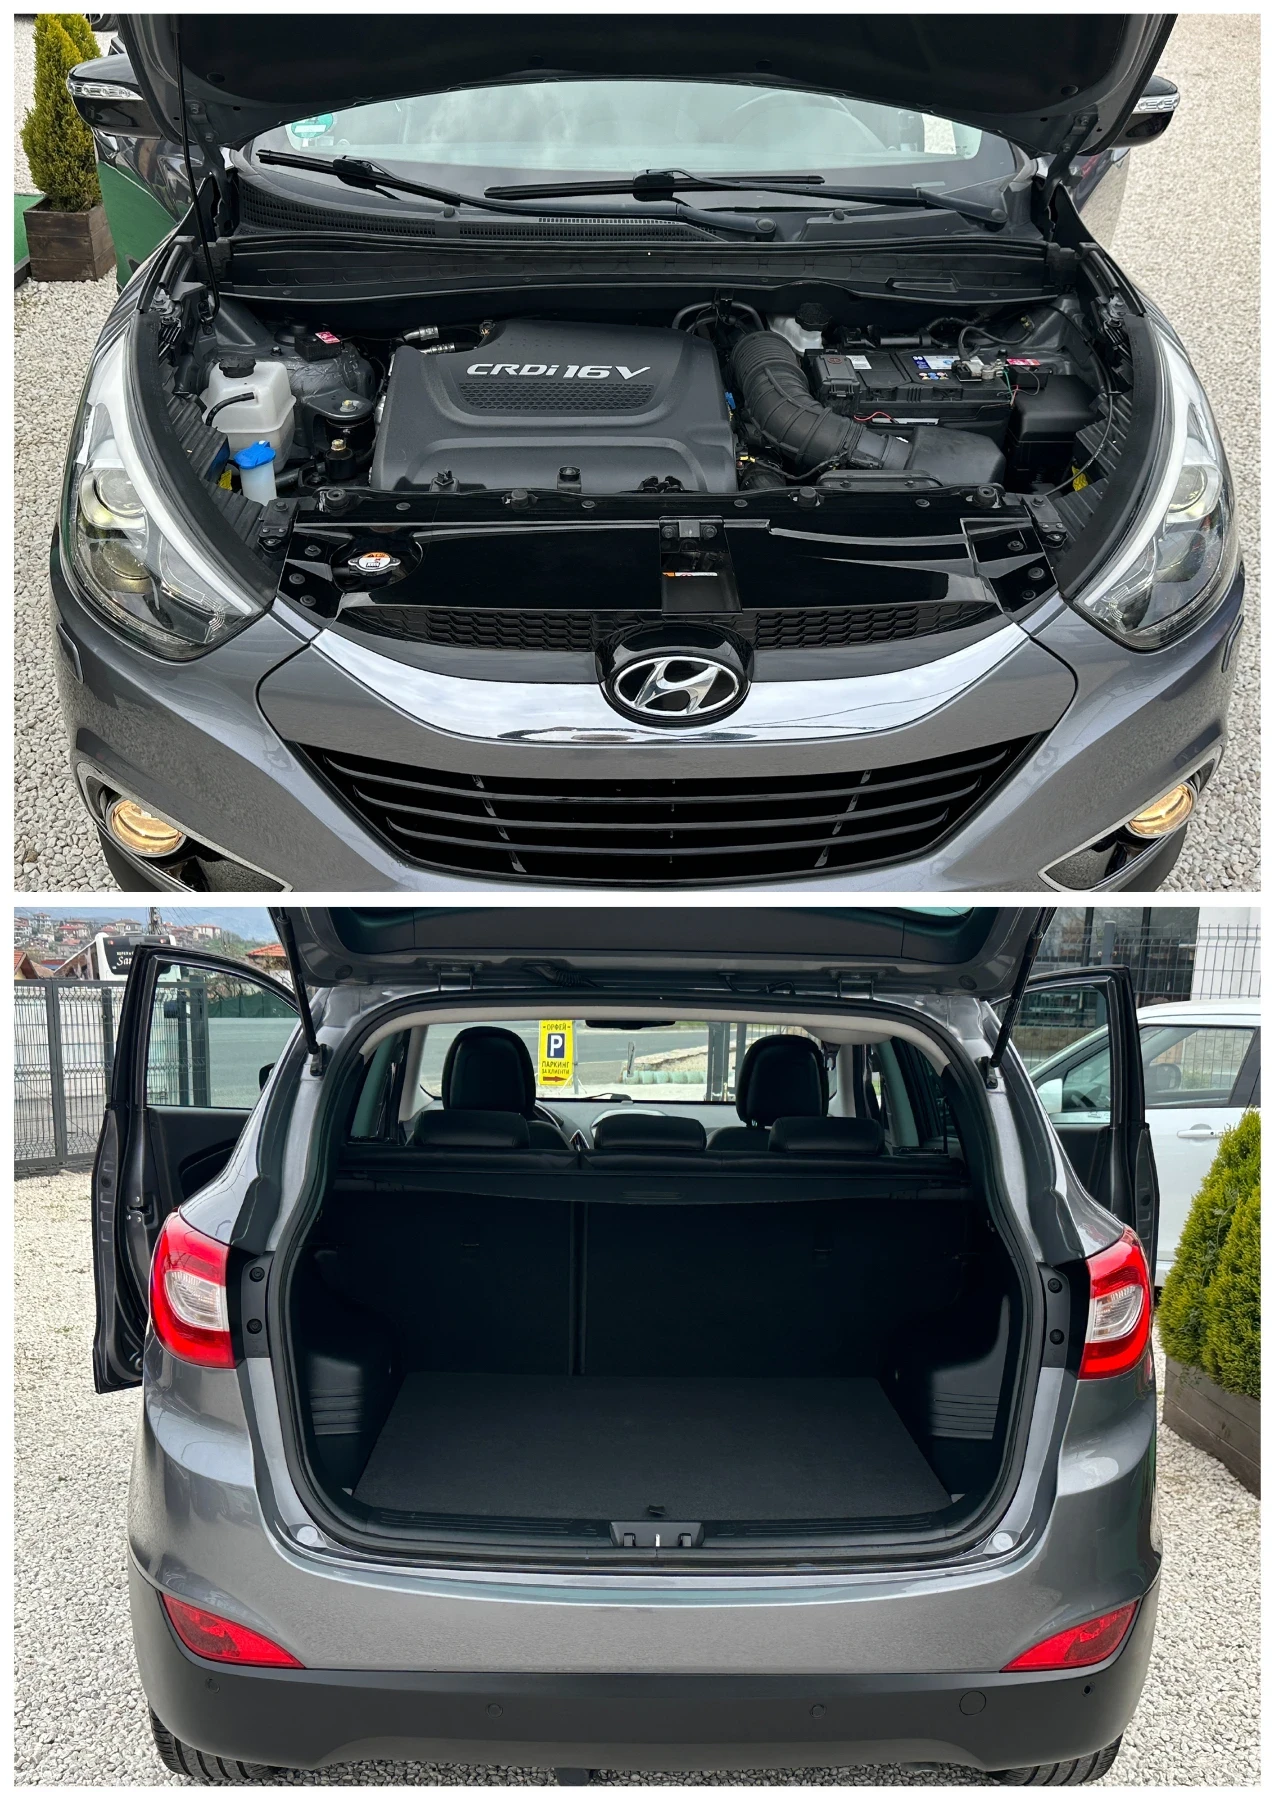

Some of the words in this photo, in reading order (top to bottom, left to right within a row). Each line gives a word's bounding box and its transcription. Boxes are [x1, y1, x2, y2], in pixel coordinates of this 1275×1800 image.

[466, 363, 560, 376] CRDi
[563, 364, 651, 380] 16V
[550, 1034, 563, 1057] P
